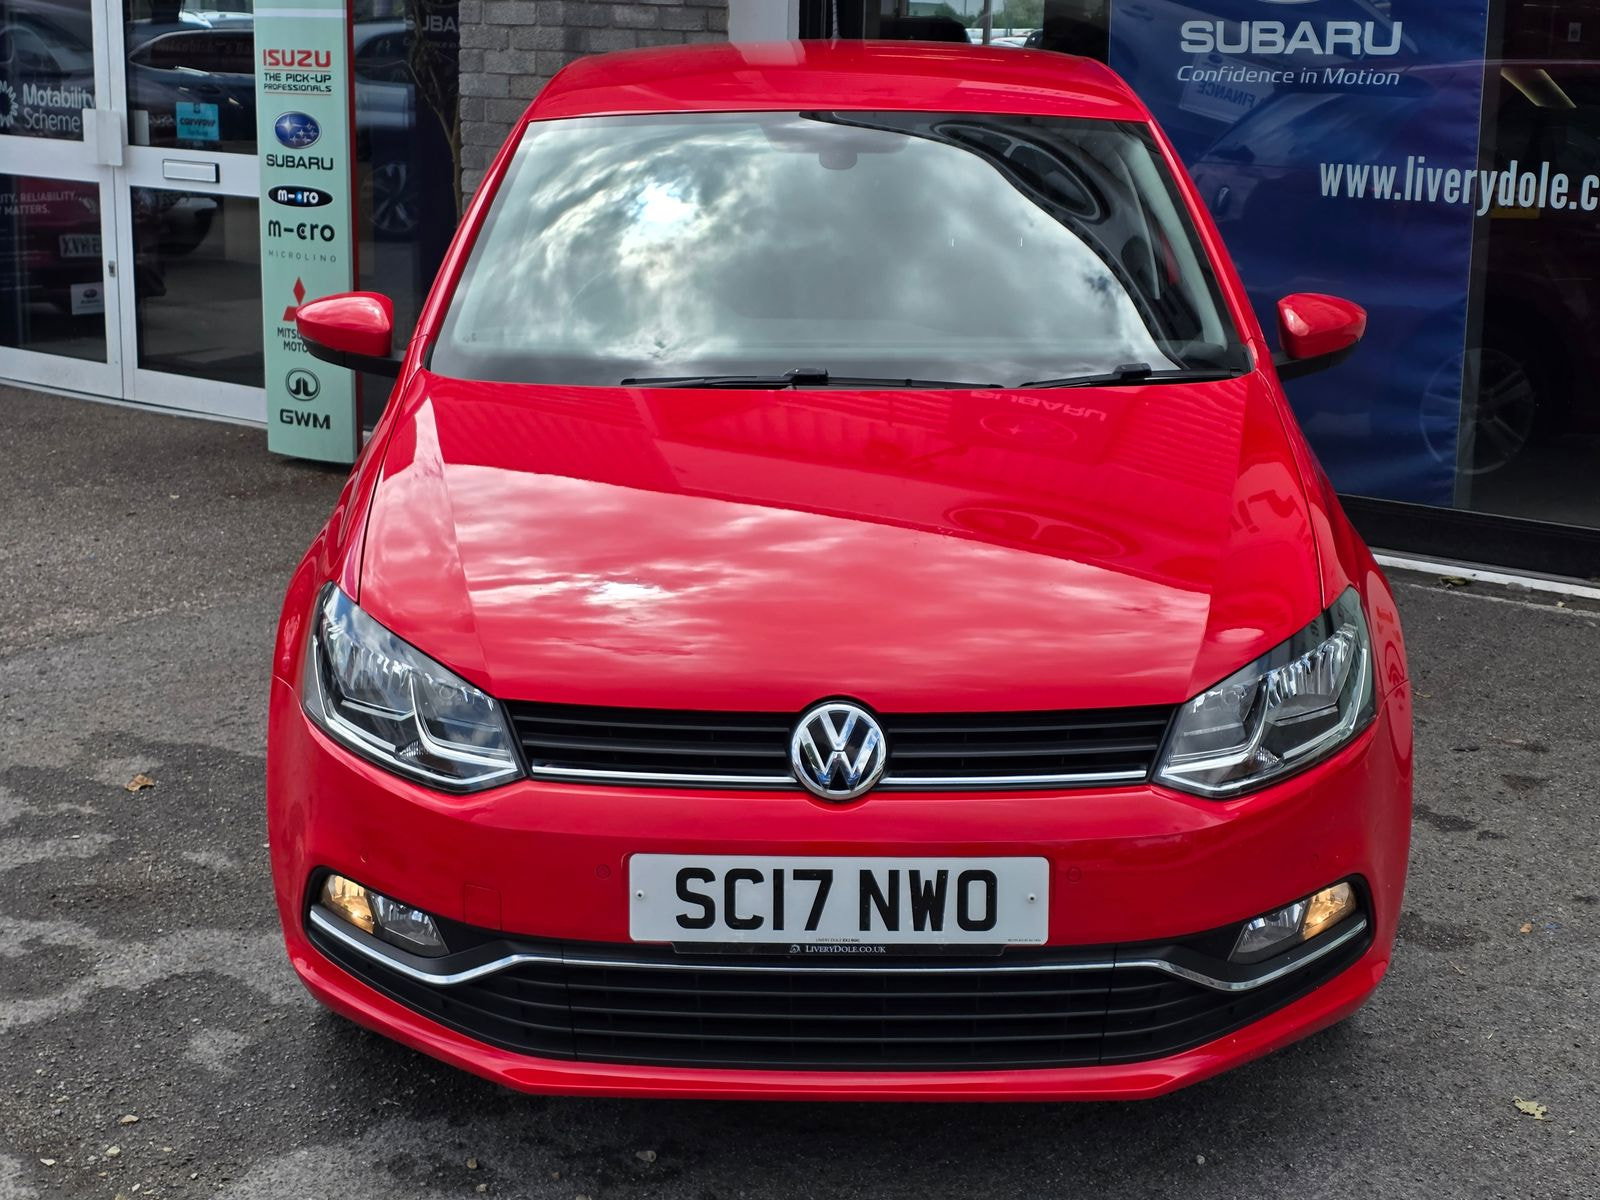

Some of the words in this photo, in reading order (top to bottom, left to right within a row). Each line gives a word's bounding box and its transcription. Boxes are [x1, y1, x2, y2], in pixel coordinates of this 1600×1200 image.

[1180, 20, 1403, 56] SUBARU
[263, 49, 331, 68] ISUZU
[264, 72, 281, 82] THE
[285, 73, 332, 83] PICK-UP
[1177, 65, 1294, 84] Confidence
[1300, 67, 1317, 84] in
[1323, 68, 1400, 86] Motion
[23, 83, 96, 109] Motability
[263, 83, 332, 93] PROFESSIONALS
[23, 107, 81, 132] Scheme
[266, 154, 334, 171] SUBARU
[1320, 155, 1600, 217] www.liverydole.c
[268, 249, 337, 263] MICROLINO
[280, 408, 331, 430] GWM
[675, 867, 834, 932] SC17
[859, 868, 998, 932] NWO
